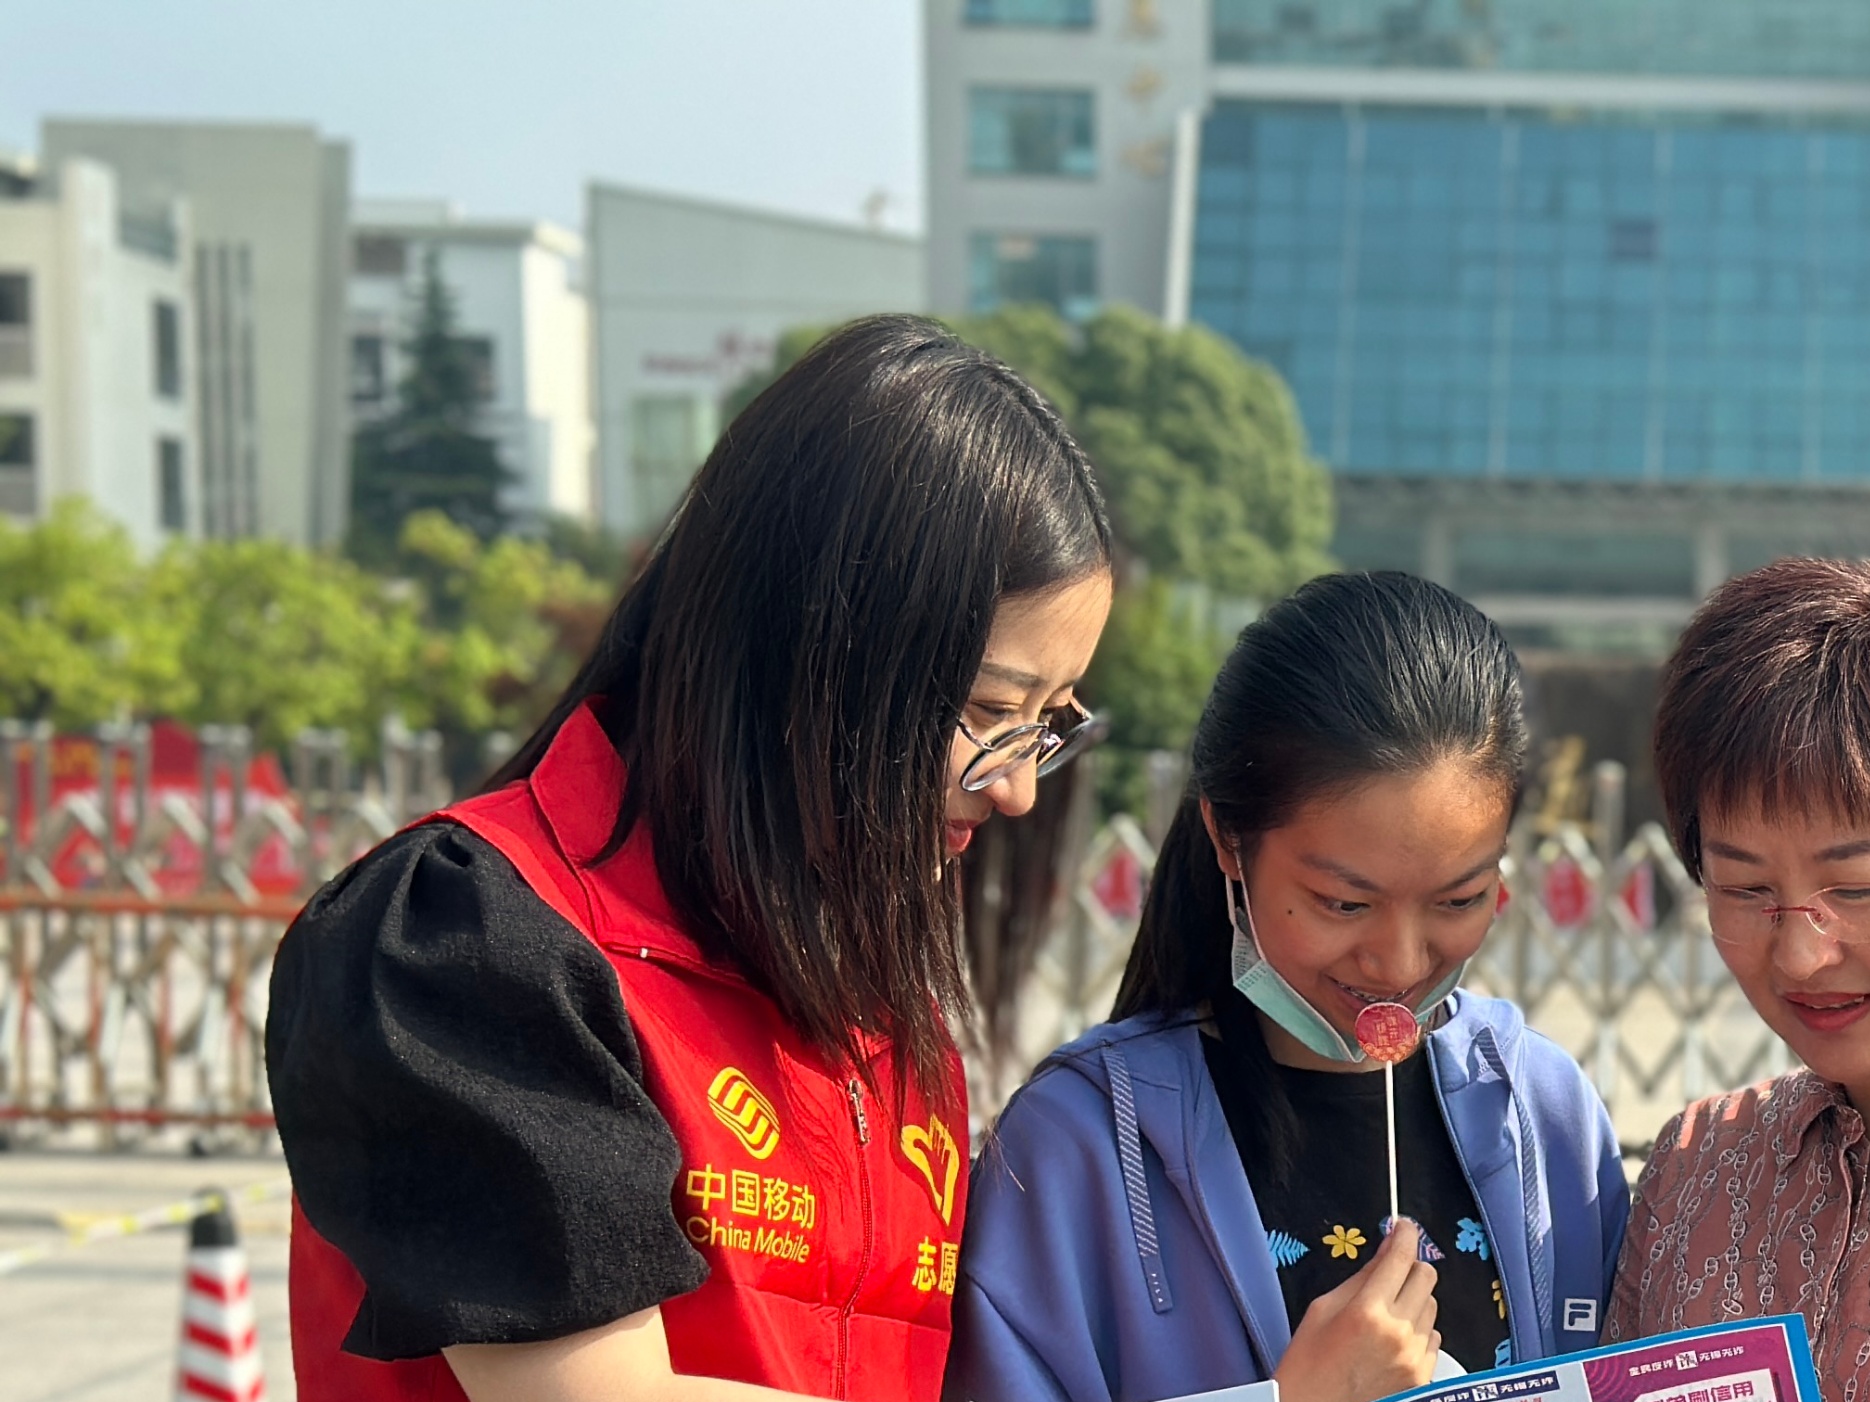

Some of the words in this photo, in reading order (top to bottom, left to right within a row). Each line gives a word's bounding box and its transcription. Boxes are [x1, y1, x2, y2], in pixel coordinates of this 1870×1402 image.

[686, 1163, 816, 1230] 中国移动
[686, 1215, 751, 1251] China
[753, 1226, 811, 1263] Mobile
[1629, 1359, 1674, 1377] 全民反诈
